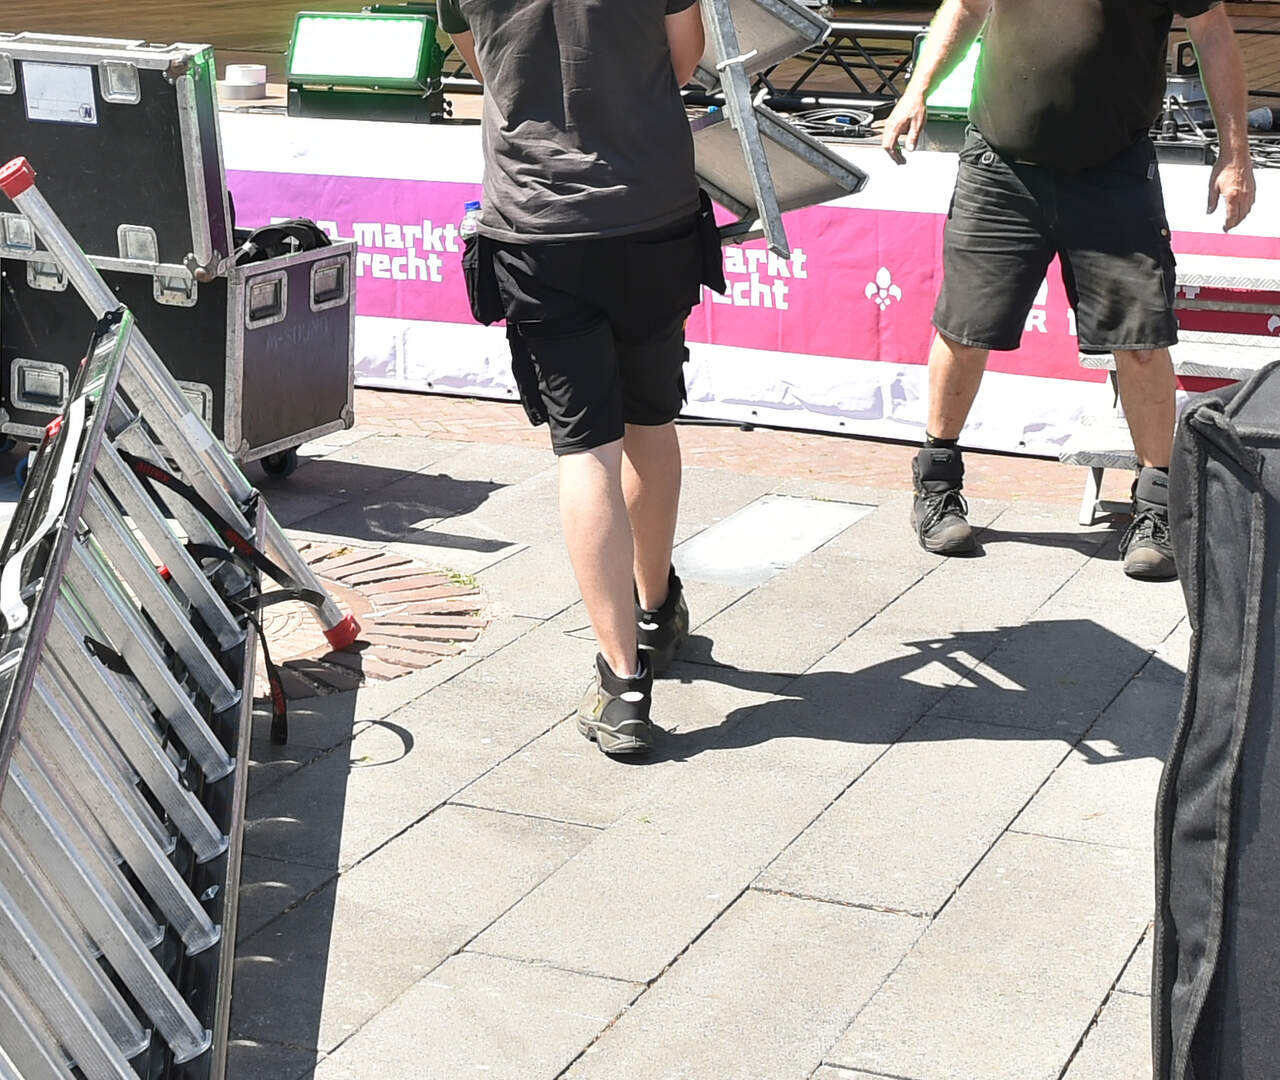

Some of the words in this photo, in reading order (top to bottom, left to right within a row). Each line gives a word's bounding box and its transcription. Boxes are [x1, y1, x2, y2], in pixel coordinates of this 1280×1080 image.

[352, 220, 460, 252] markt
[355, 242, 443, 282] recht
[725, 245, 808, 279] arkt
